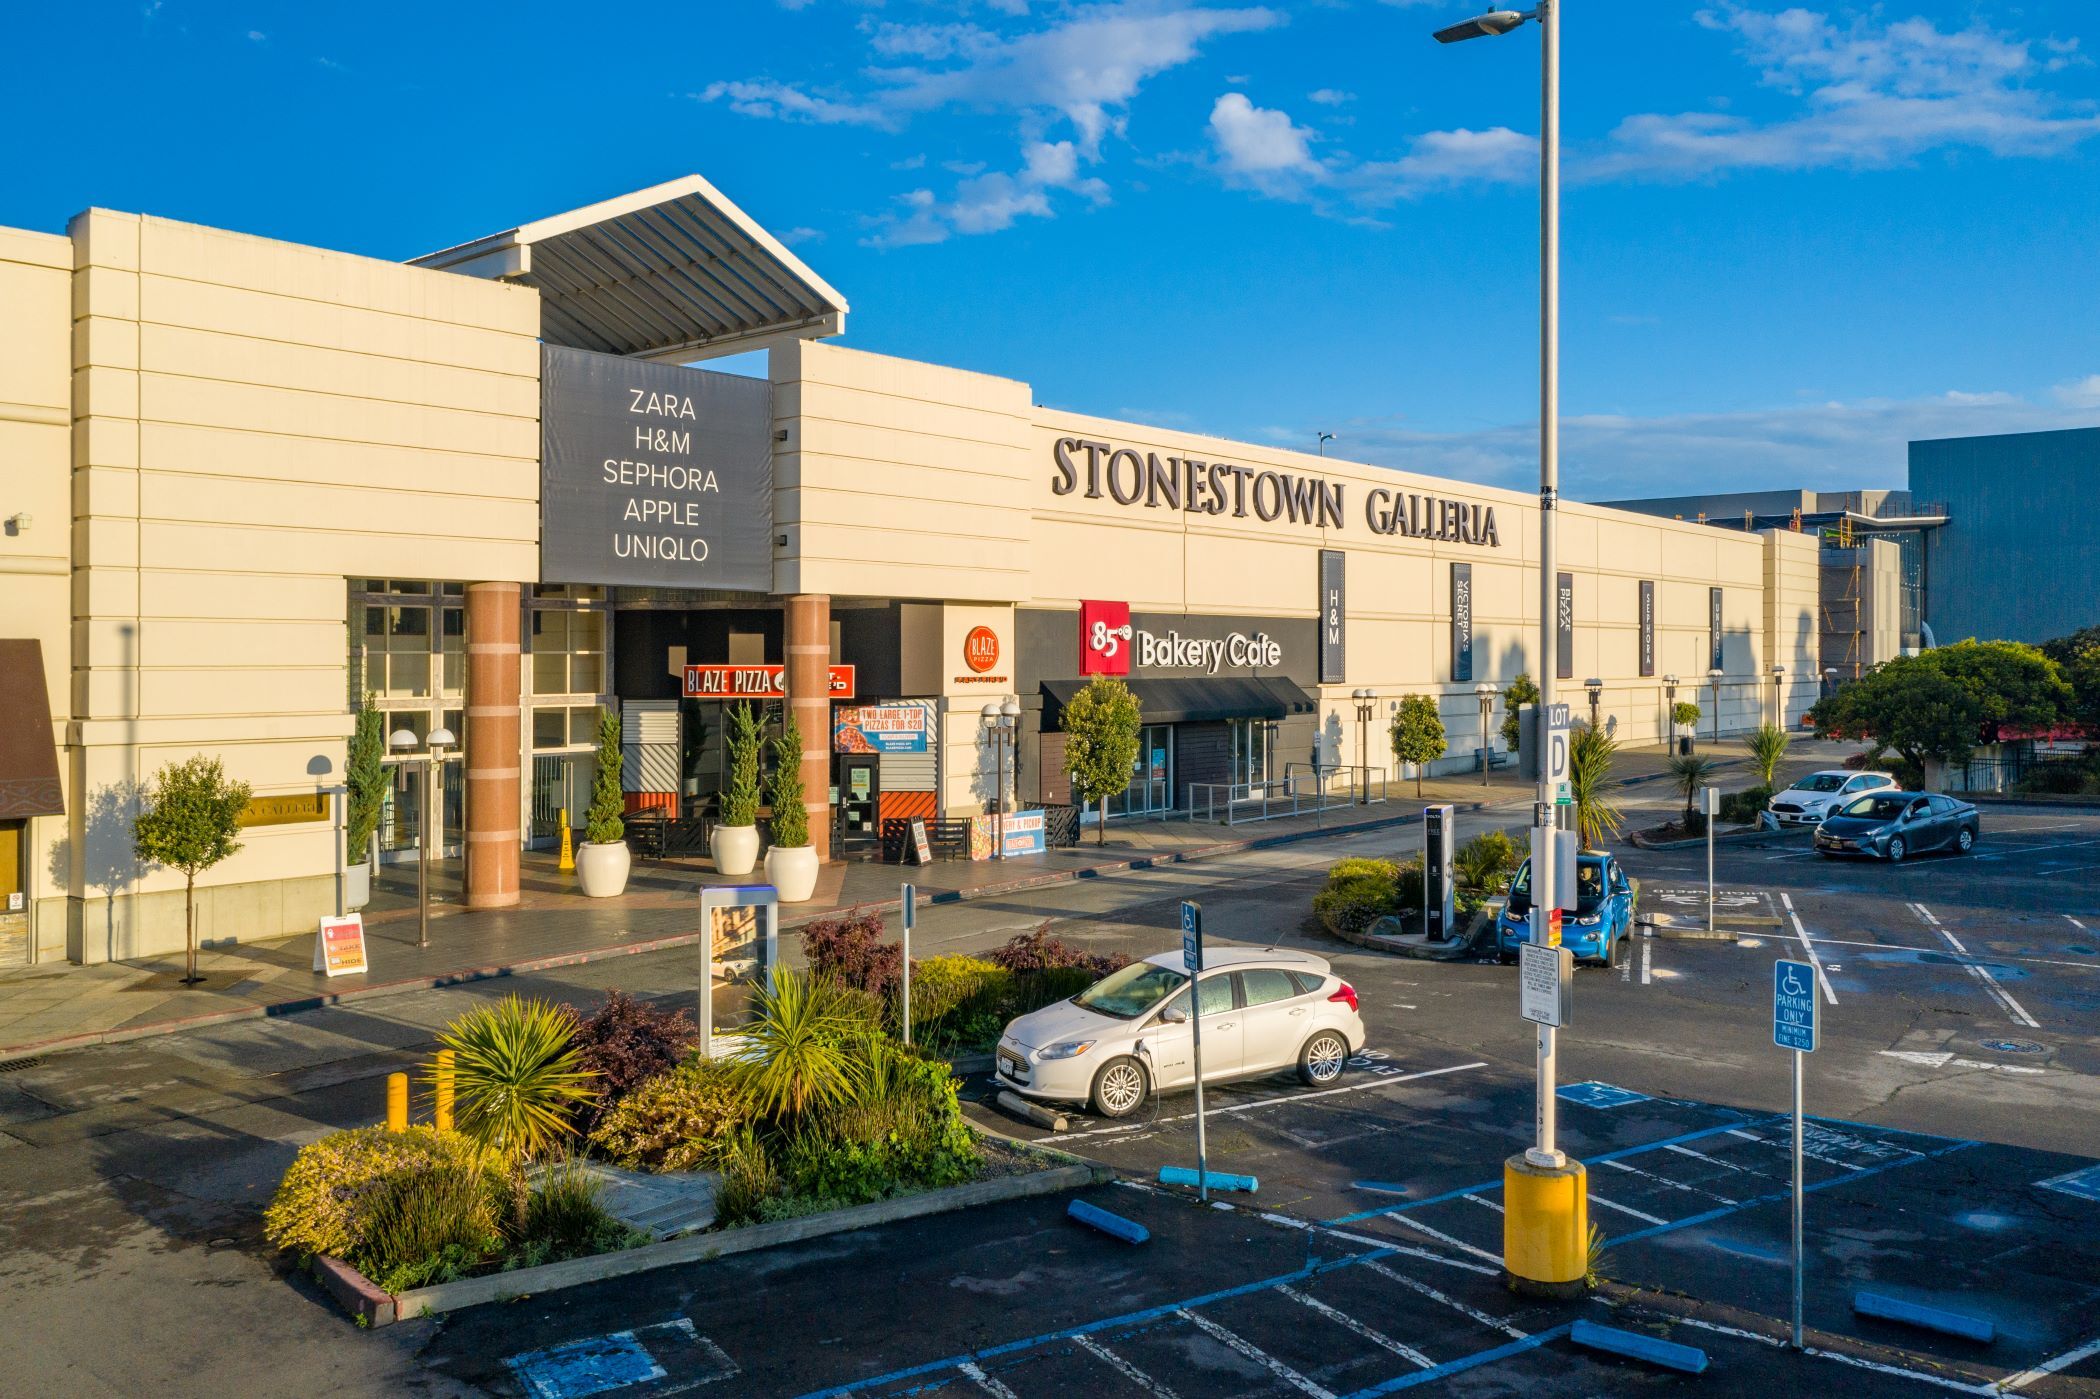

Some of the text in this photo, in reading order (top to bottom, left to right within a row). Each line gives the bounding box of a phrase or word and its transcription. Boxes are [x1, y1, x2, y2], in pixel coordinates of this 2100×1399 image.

[629, 388, 696, 421] ZARA
[636, 426, 690, 455] H&M
[603, 459, 719, 493] SEPHORA
[1052, 437, 1501, 548] STONESTOWN GALLERIA
[624, 498, 699, 526] APPLE
[615, 533, 709, 562] UNIQLO
[1328, 589, 1340, 645] H&M
[1462, 580, 1470, 652] VICTORIA'S
[971, 636, 995, 656] BLAZE
[1136, 630, 1224, 675] Bakery
[1225, 632, 1282, 668] Cafe
[687, 669, 771, 693] BLAZE PIZZA
[863, 709, 877, 720] TWO
[880, 709, 901, 719] LARGE
[865, 720, 923, 731] PIZZAS FOR $20
[1550, 708, 1568, 726] LOT
[1552, 735, 1565, 777] D
[1777, 993, 1812, 1012] PARKING
[1783, 1008, 1805, 1023] ONLY
[1779, 1033, 1810, 1048] FINE $250
[1782, 1024, 1807, 1038] MINIMUM
